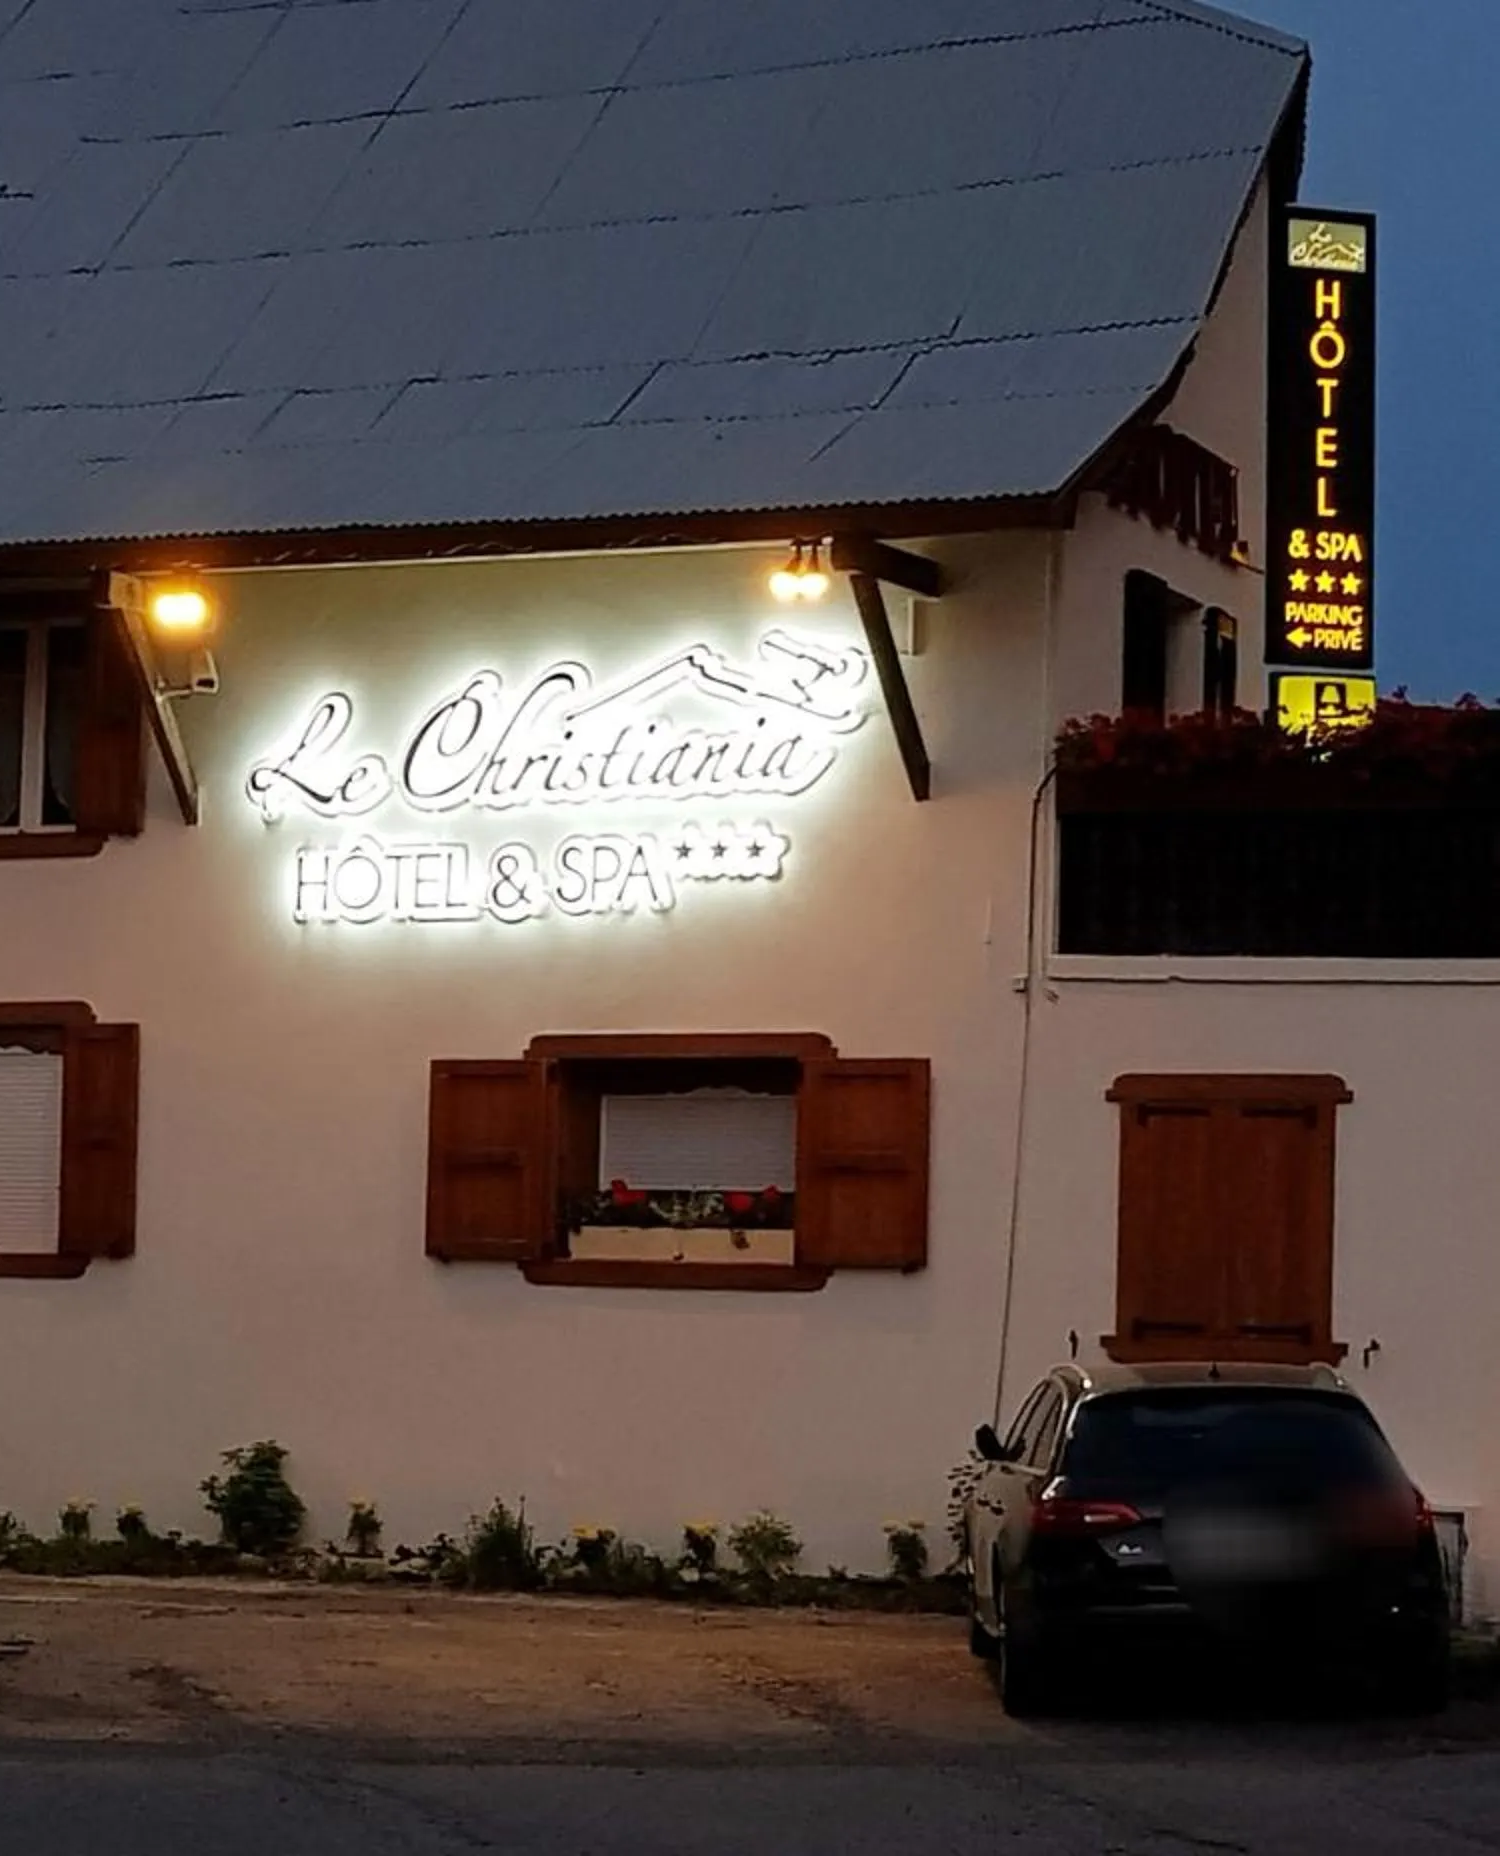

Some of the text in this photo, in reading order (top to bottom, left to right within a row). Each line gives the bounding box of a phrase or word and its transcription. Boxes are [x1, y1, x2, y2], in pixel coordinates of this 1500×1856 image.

[1310, 278, 1345, 517] HÔTEL
[1288, 528, 1362, 562] & SPA
[1285, 601, 1363, 626] PARKING
[1313, 627, 1363, 651] PRIVÉ
[248, 672, 804, 806] Le Christiania
[296, 844, 661, 911] HÔTEL & SPA
